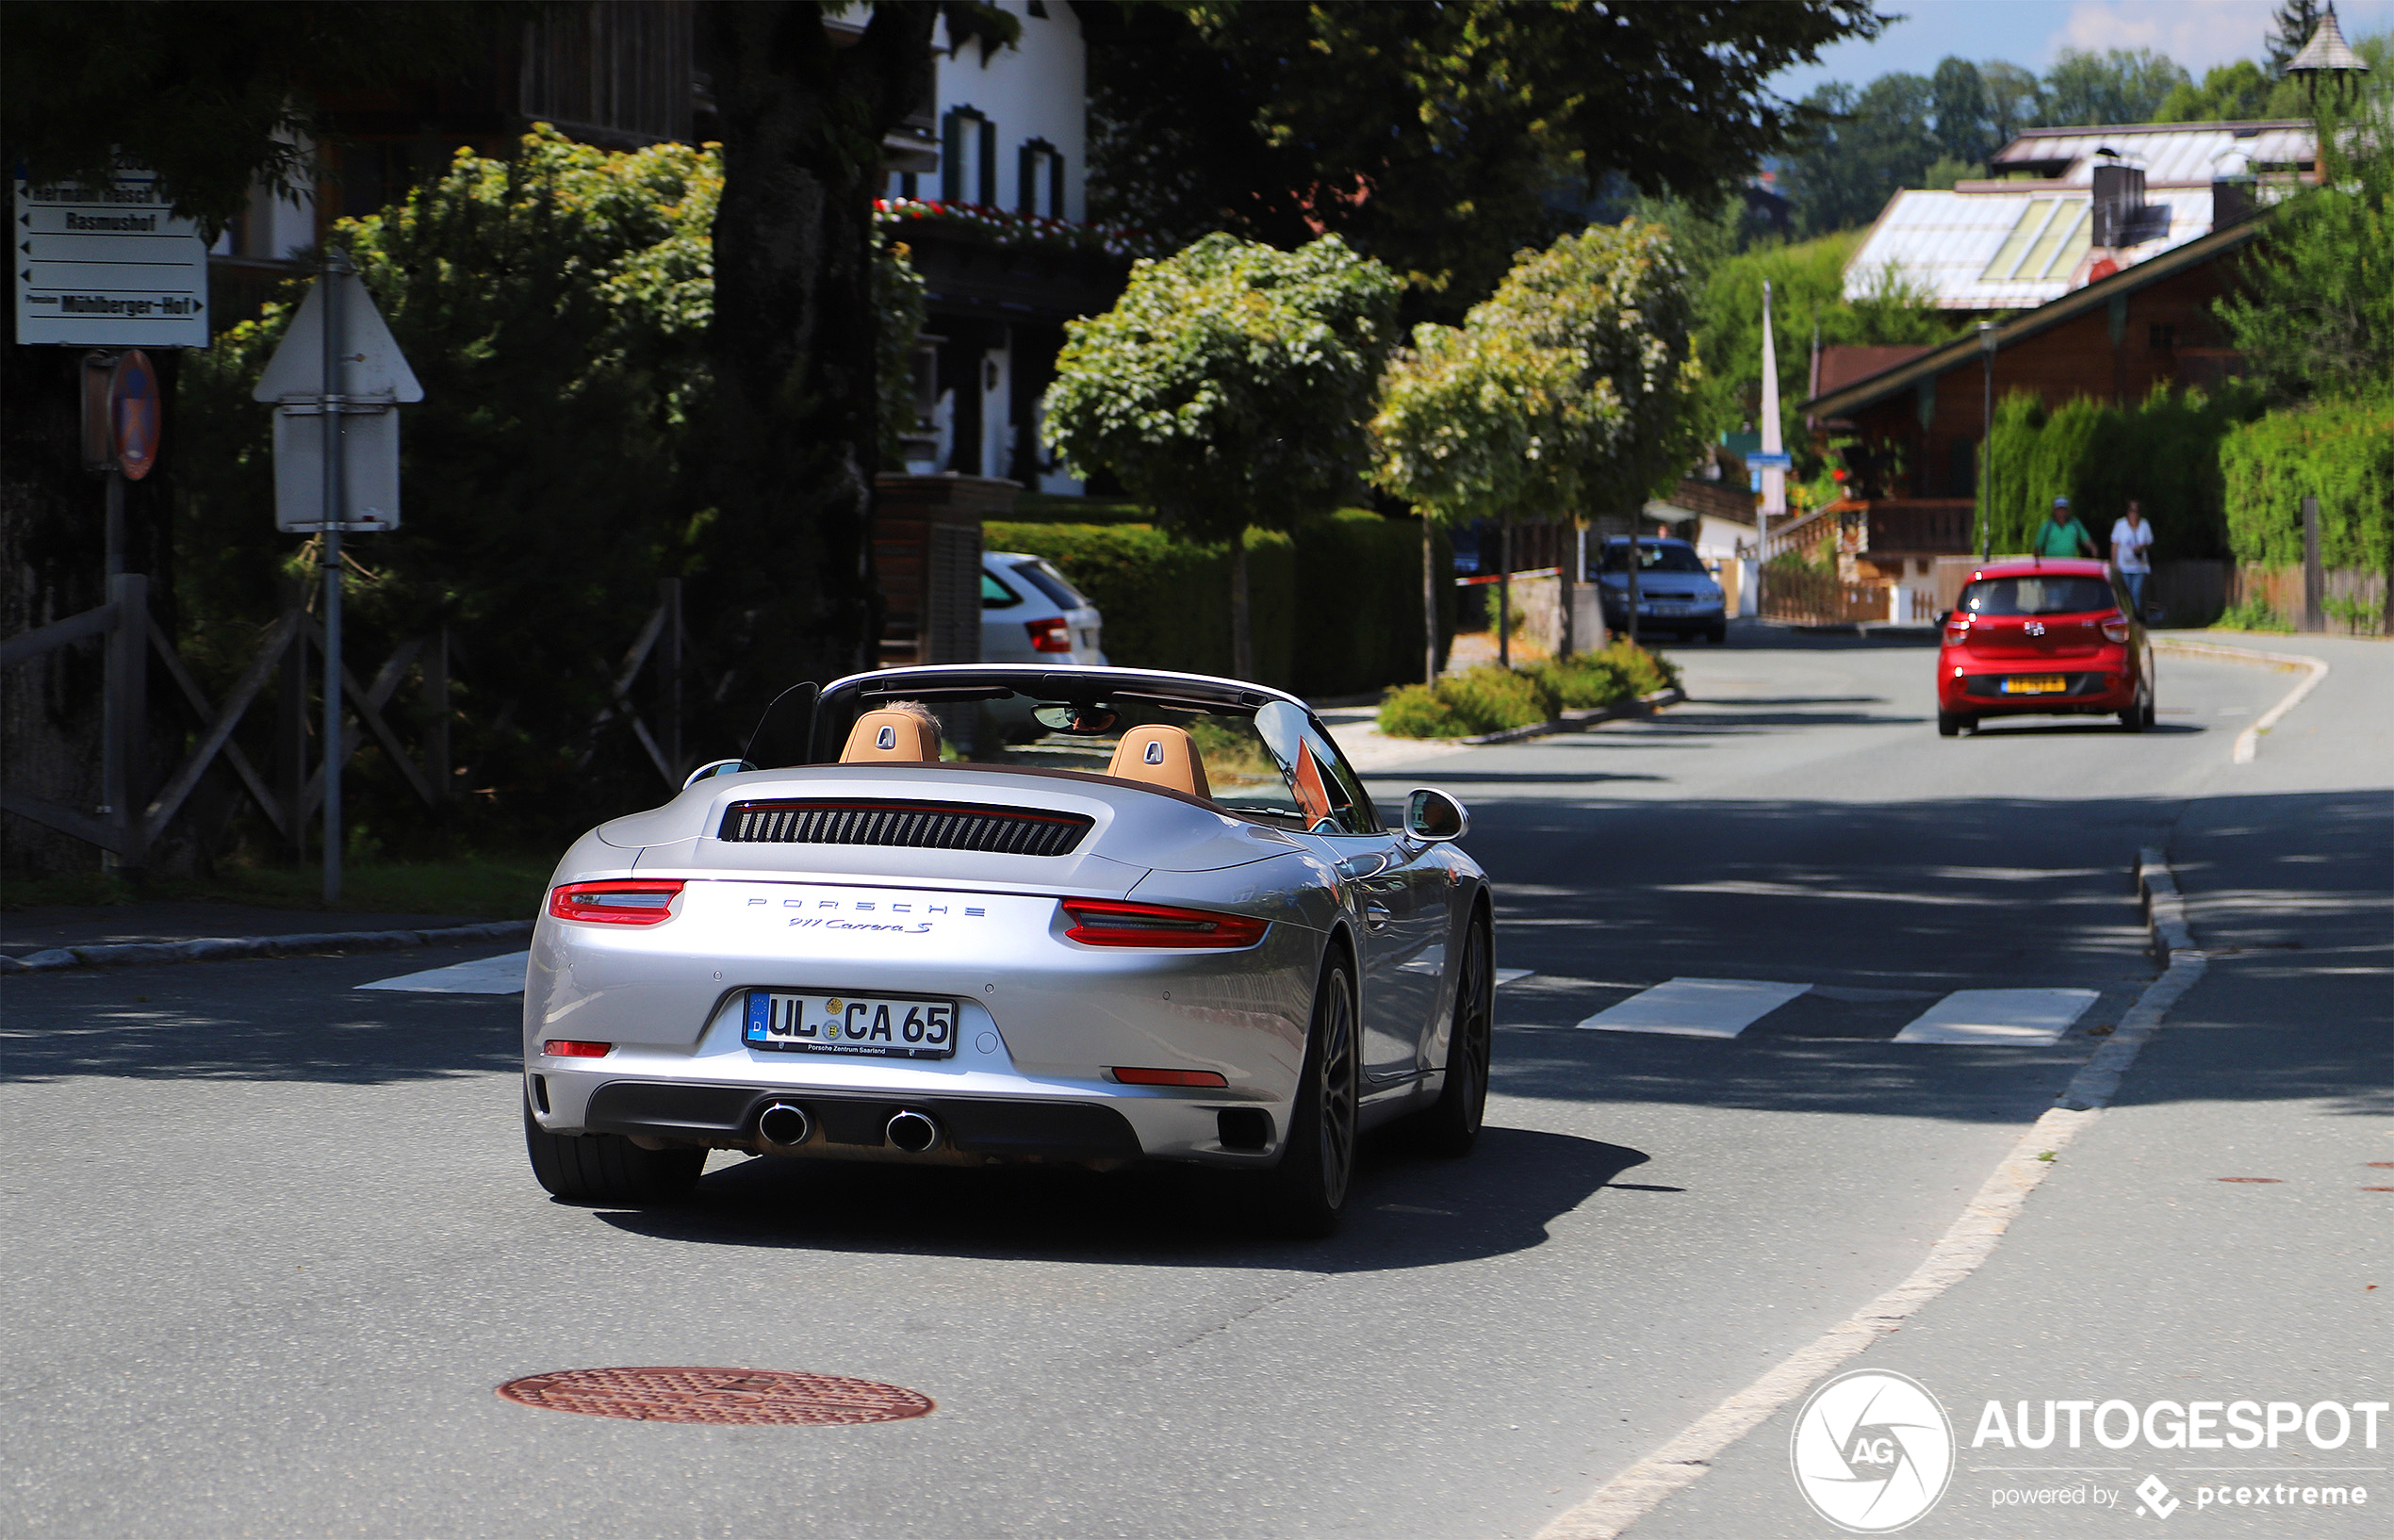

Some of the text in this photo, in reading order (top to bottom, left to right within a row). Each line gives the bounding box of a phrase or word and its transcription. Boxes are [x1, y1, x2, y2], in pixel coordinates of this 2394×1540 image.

[65, 212, 156, 231] Rasmushof
[61, 295, 190, 316] Mühlberger-Hof
[747, 898, 986, 917] PORSCHE
[788, 917, 932, 933] 911 Carrera S
[753, 999, 950, 1044] D UL CA 65
[808, 1043, 886, 1055] Porsche Zentrum Saarland
